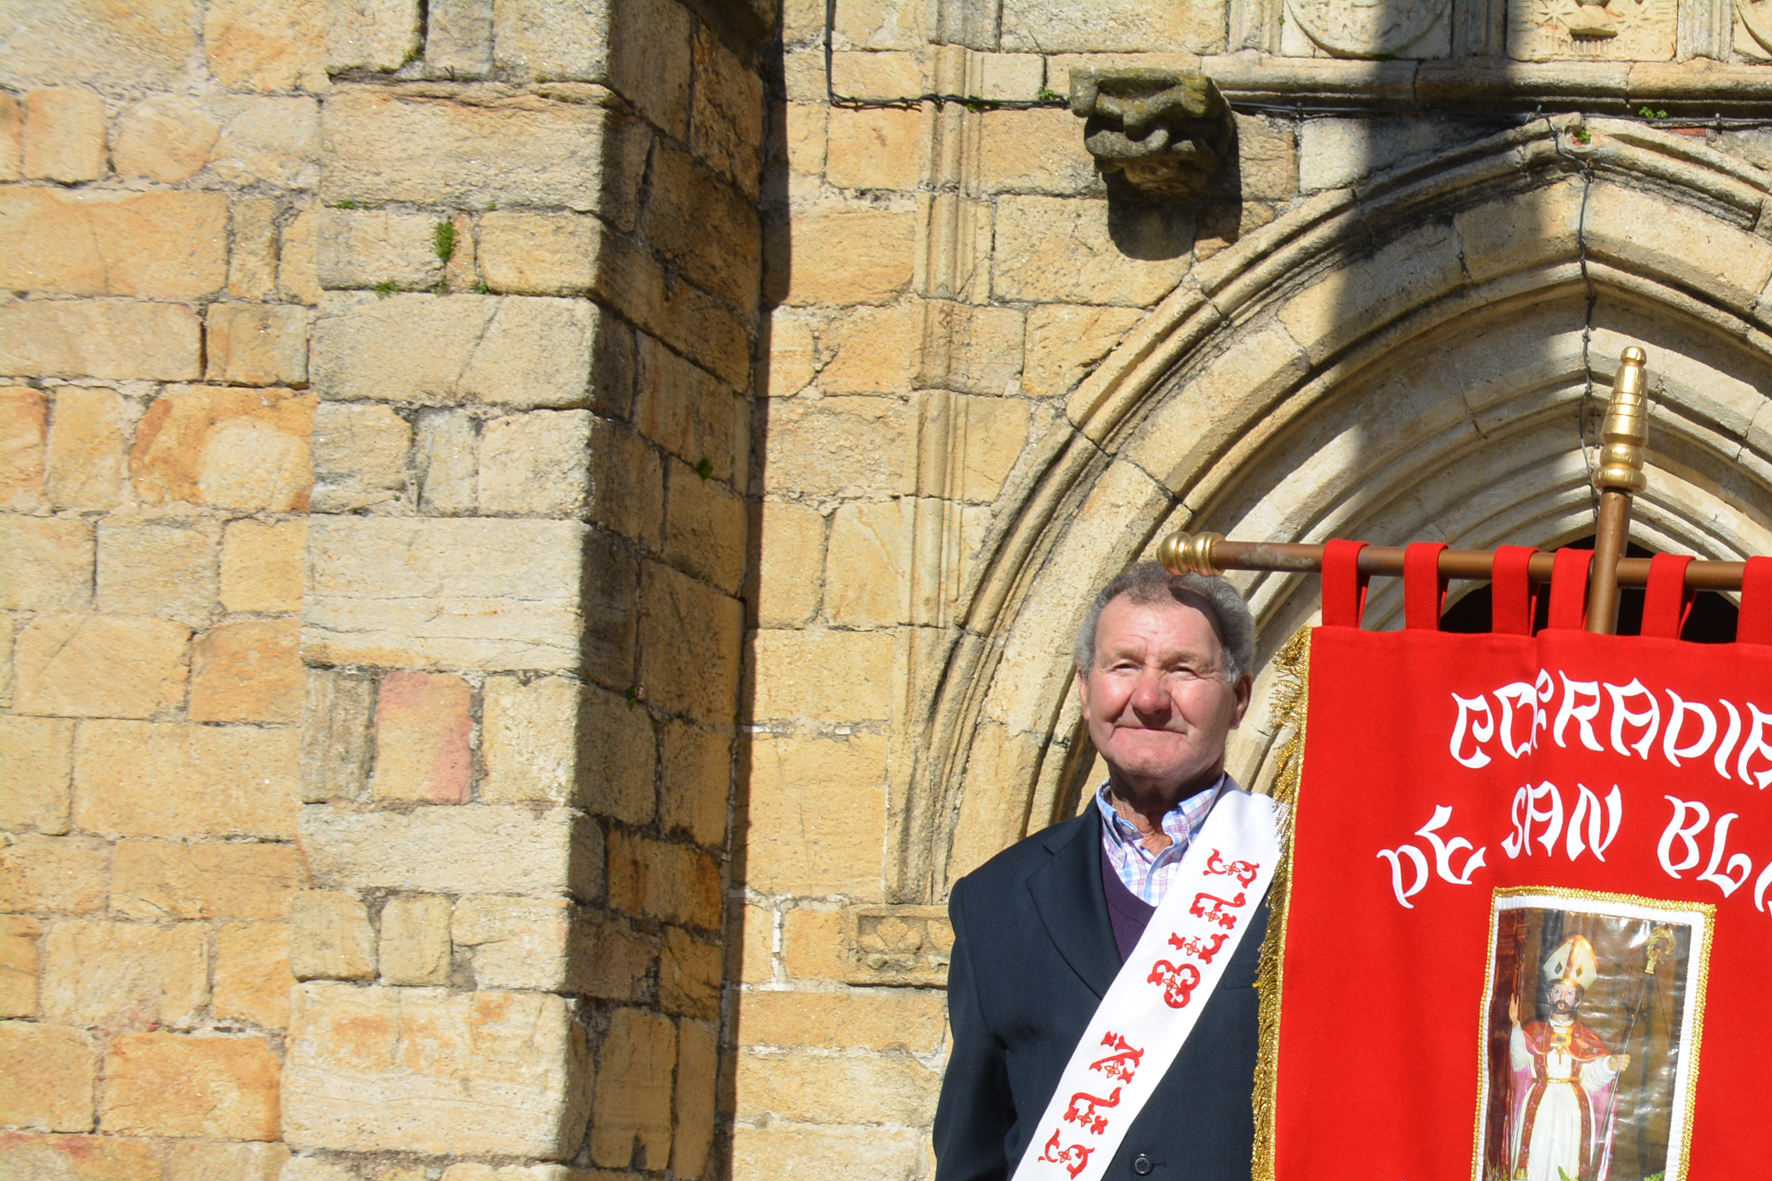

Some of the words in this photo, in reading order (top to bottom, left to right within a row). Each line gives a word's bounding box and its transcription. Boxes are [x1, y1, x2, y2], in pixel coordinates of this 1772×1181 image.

[1377, 805, 1486, 908] DE
[1510, 781, 1622, 862] SAN
[1038, 1031, 1146, 1180] SAN
[1147, 848, 1260, 1009] BLAS
